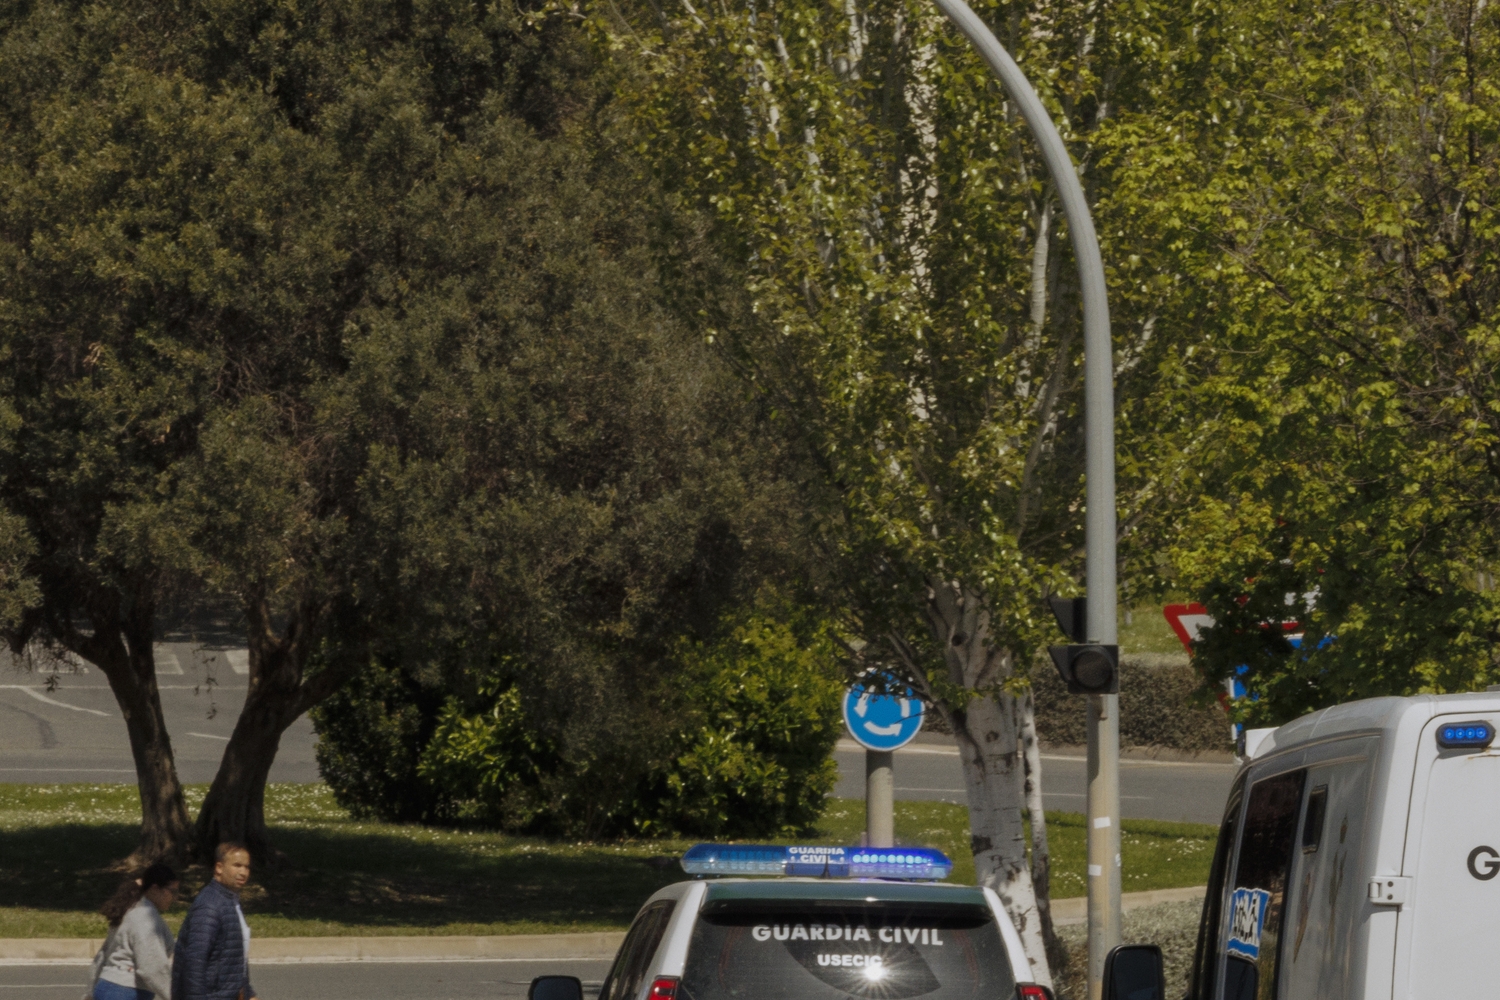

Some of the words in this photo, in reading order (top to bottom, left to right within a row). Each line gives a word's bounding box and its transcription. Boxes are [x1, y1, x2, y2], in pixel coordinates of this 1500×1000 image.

[788, 846, 845, 855] GUARDIA
[800, 854, 834, 864] CIVIL
[752, 924, 871, 942] GUARDIA
[879, 926, 944, 946] CIVIL
[816, 953, 883, 967] USECIC
